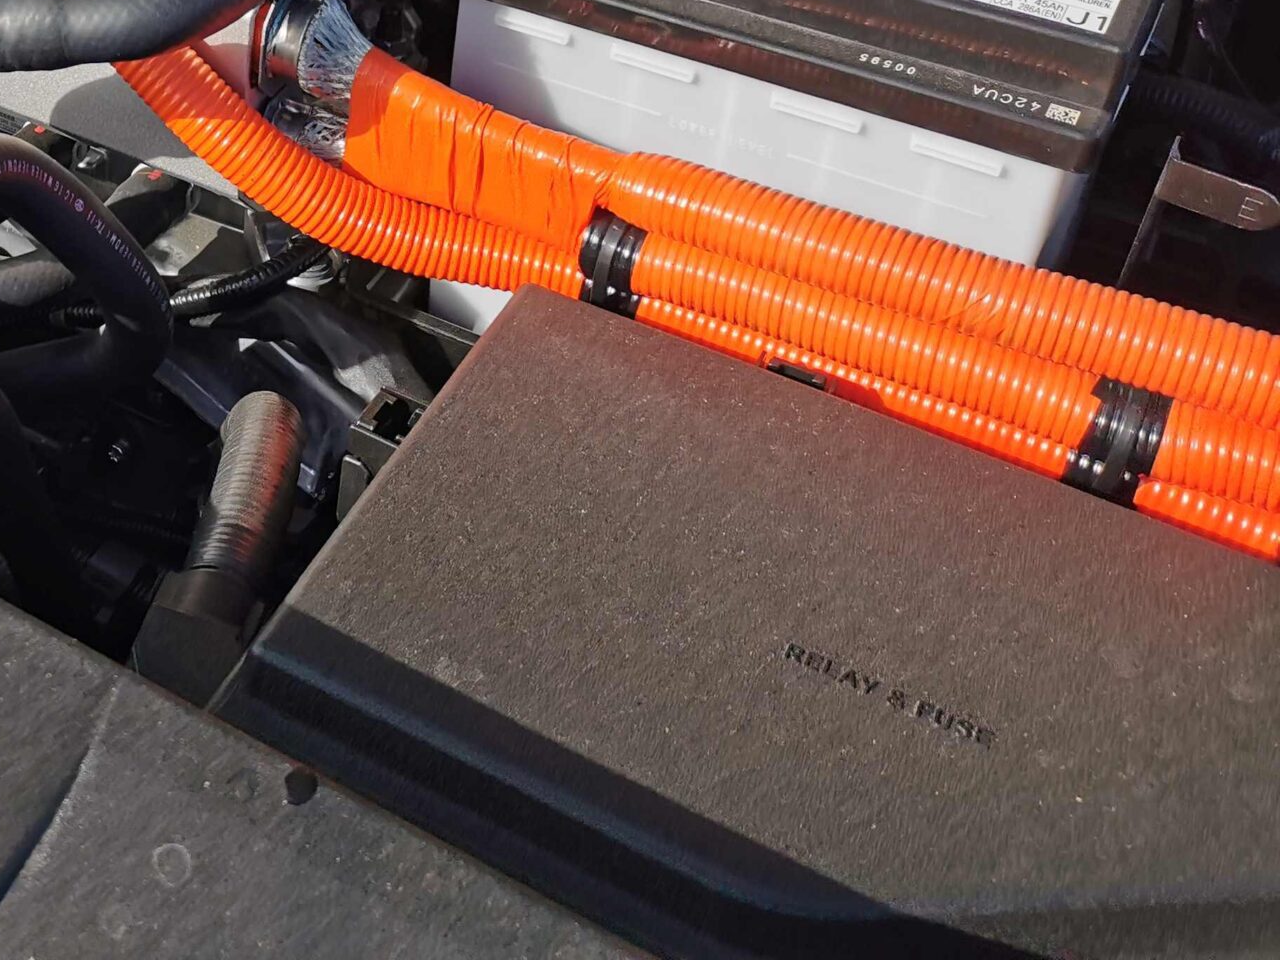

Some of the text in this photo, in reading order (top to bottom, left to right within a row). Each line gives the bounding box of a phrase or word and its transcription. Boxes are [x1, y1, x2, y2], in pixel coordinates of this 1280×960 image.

[972, 84, 1042, 110] 42CUA
[784, 642, 881, 695] RELAY
[913, 698, 997, 746] FUSE
